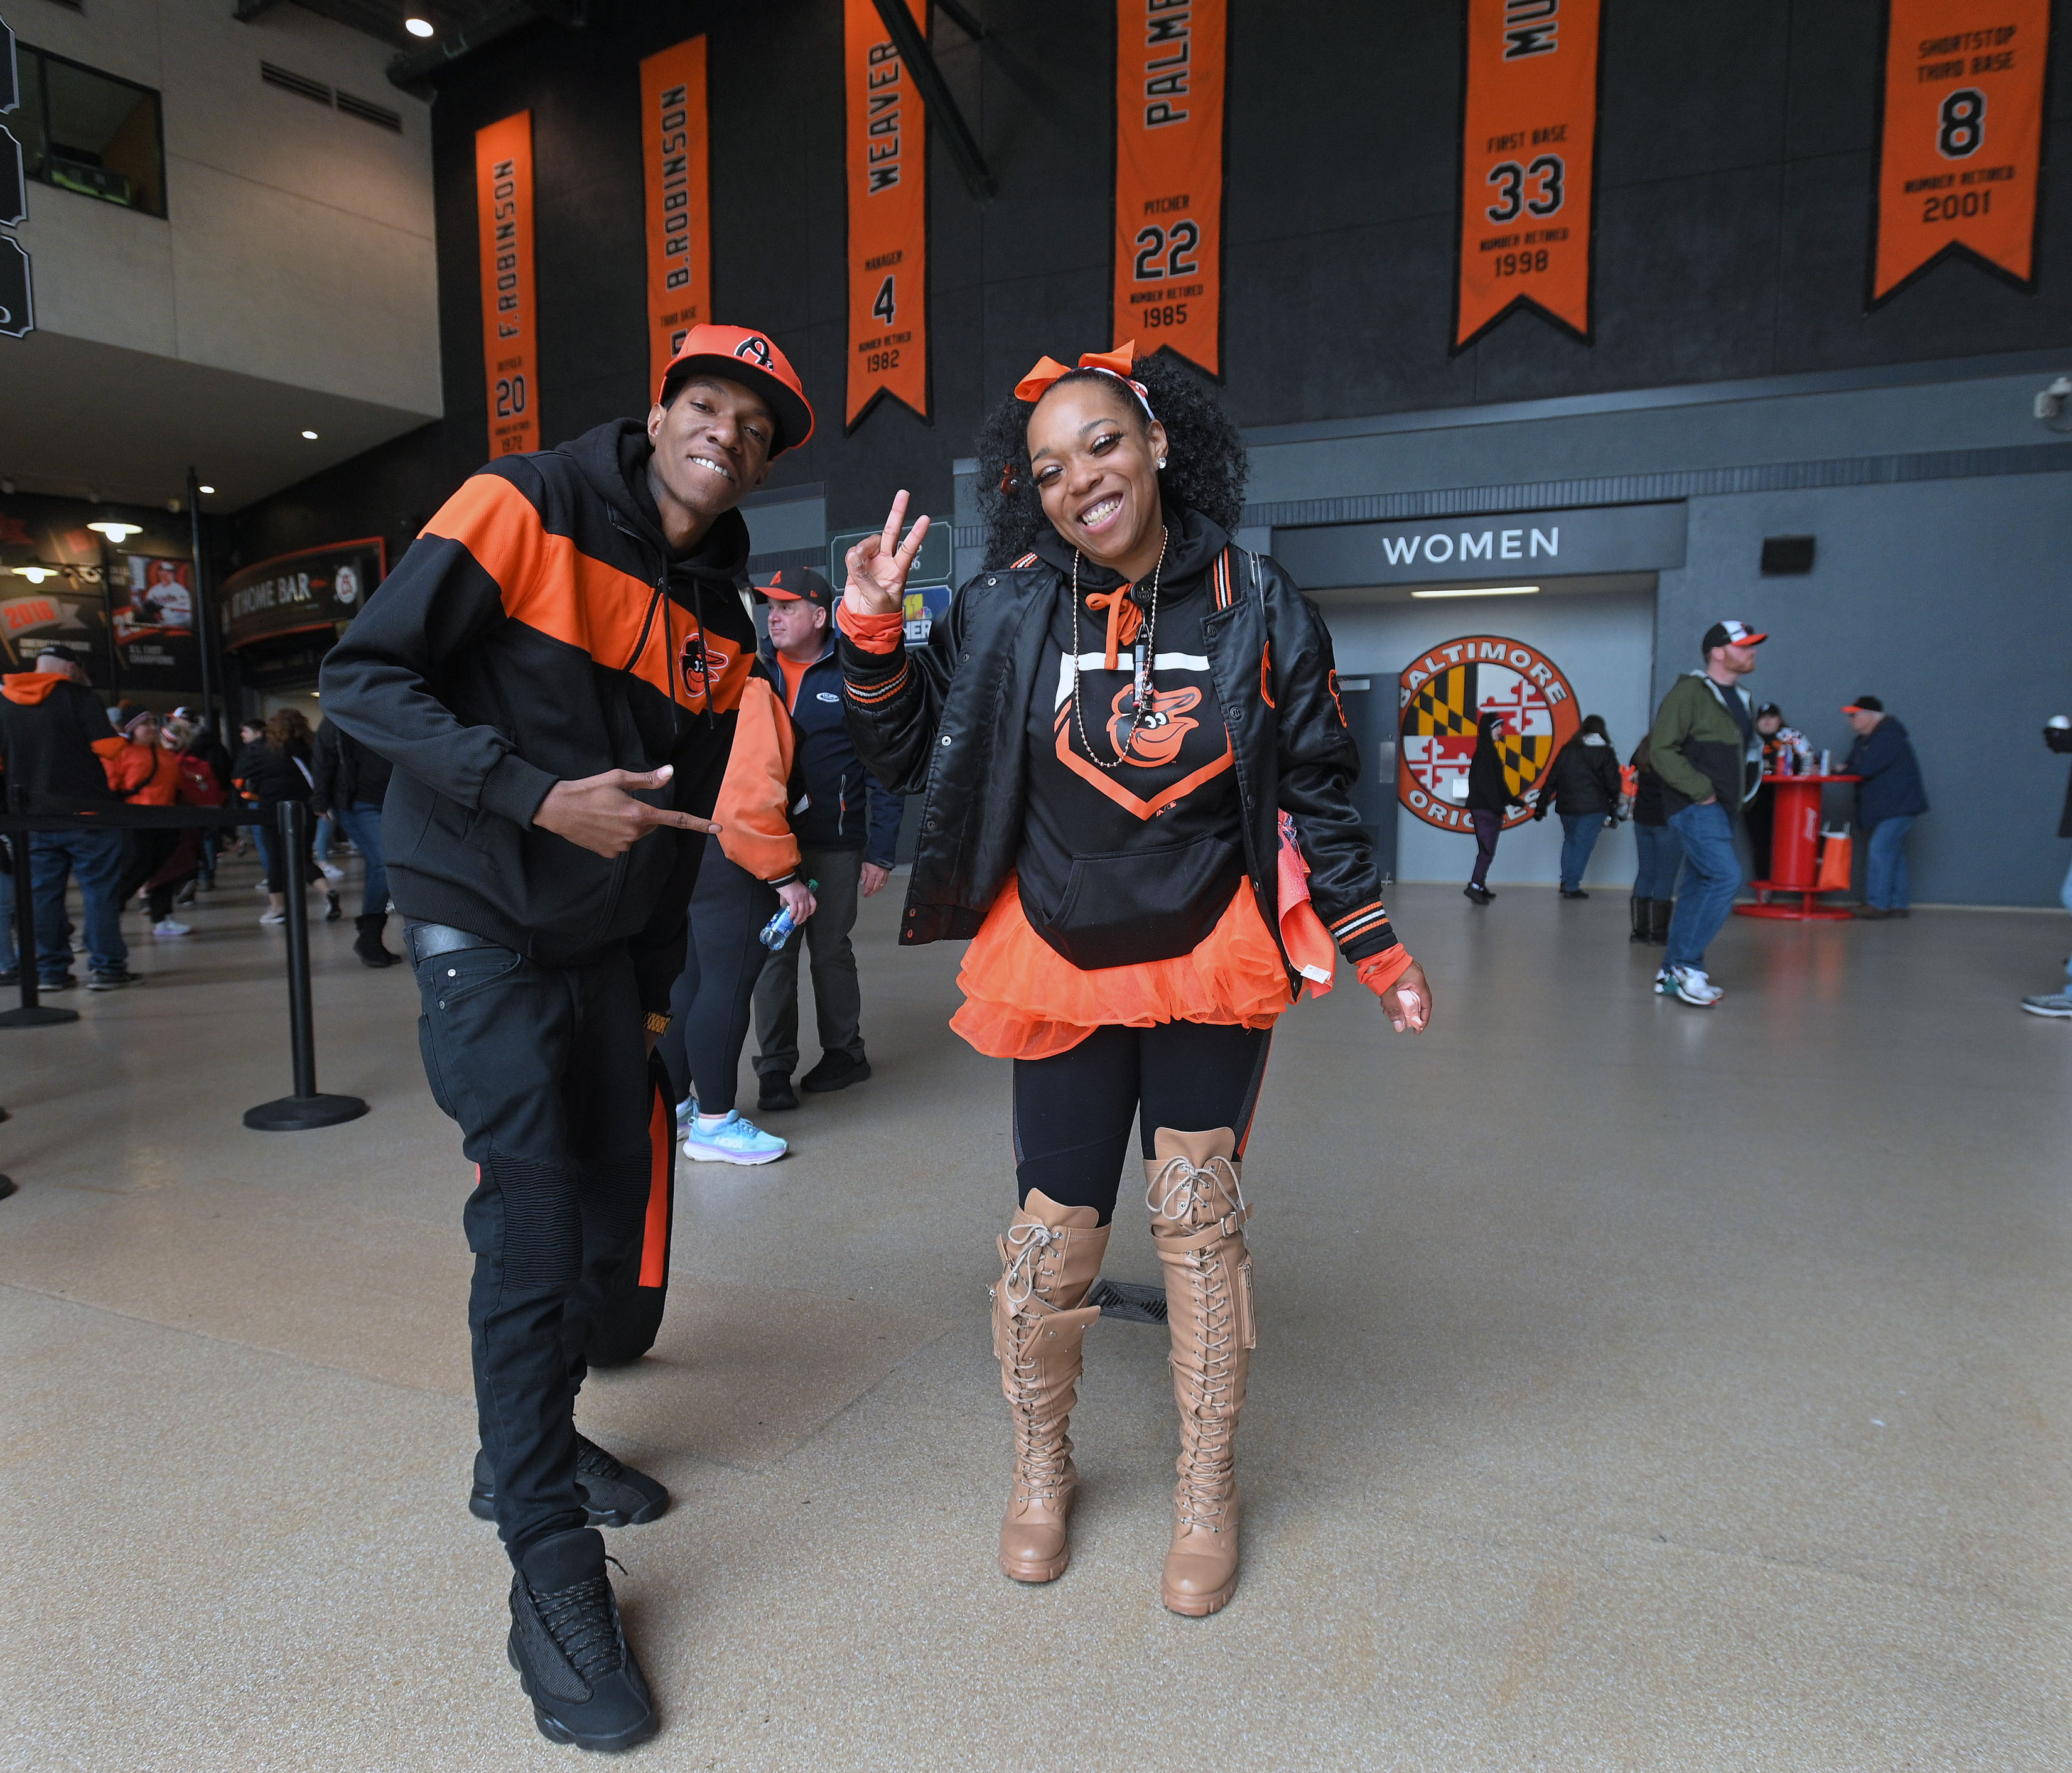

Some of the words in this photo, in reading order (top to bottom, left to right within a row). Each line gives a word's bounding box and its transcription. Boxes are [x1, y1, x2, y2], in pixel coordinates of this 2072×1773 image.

[1919, 24, 2016, 59] SHORTSTOP
[1918, 60, 1964, 83] THIRD
[1972, 50, 2014, 75] BASE
[868, 40, 901, 197] WEAVER
[1935, 86, 1988, 160] 8
[1487, 131, 1526, 153] FIRST
[1532, 124, 1568, 147] BASE
[1144, 194, 1190, 216] PITCHER
[1486, 153, 1565, 226] 33
[1922, 190, 1990, 223] 2001
[1133, 218, 1200, 281] 22
[1479, 234, 1520, 252] NUMBER
[864, 250, 903, 271] MANAGER
[1495, 249, 1549, 278] 1998
[871, 274, 897, 327] 4
[1130, 289, 1164, 304] NUMBER
[1167, 283, 1204, 299] RETIRED
[1143, 304, 1188, 328] 1985
[866, 348, 900, 374] 1982
[495, 374, 527, 420] 20
[1382, 526, 1560, 566] WOMEN
[277, 572, 312, 604] BAR
[1400, 641, 1568, 709] BALTIMORE
[1409, 788, 1541, 828] ORIES
